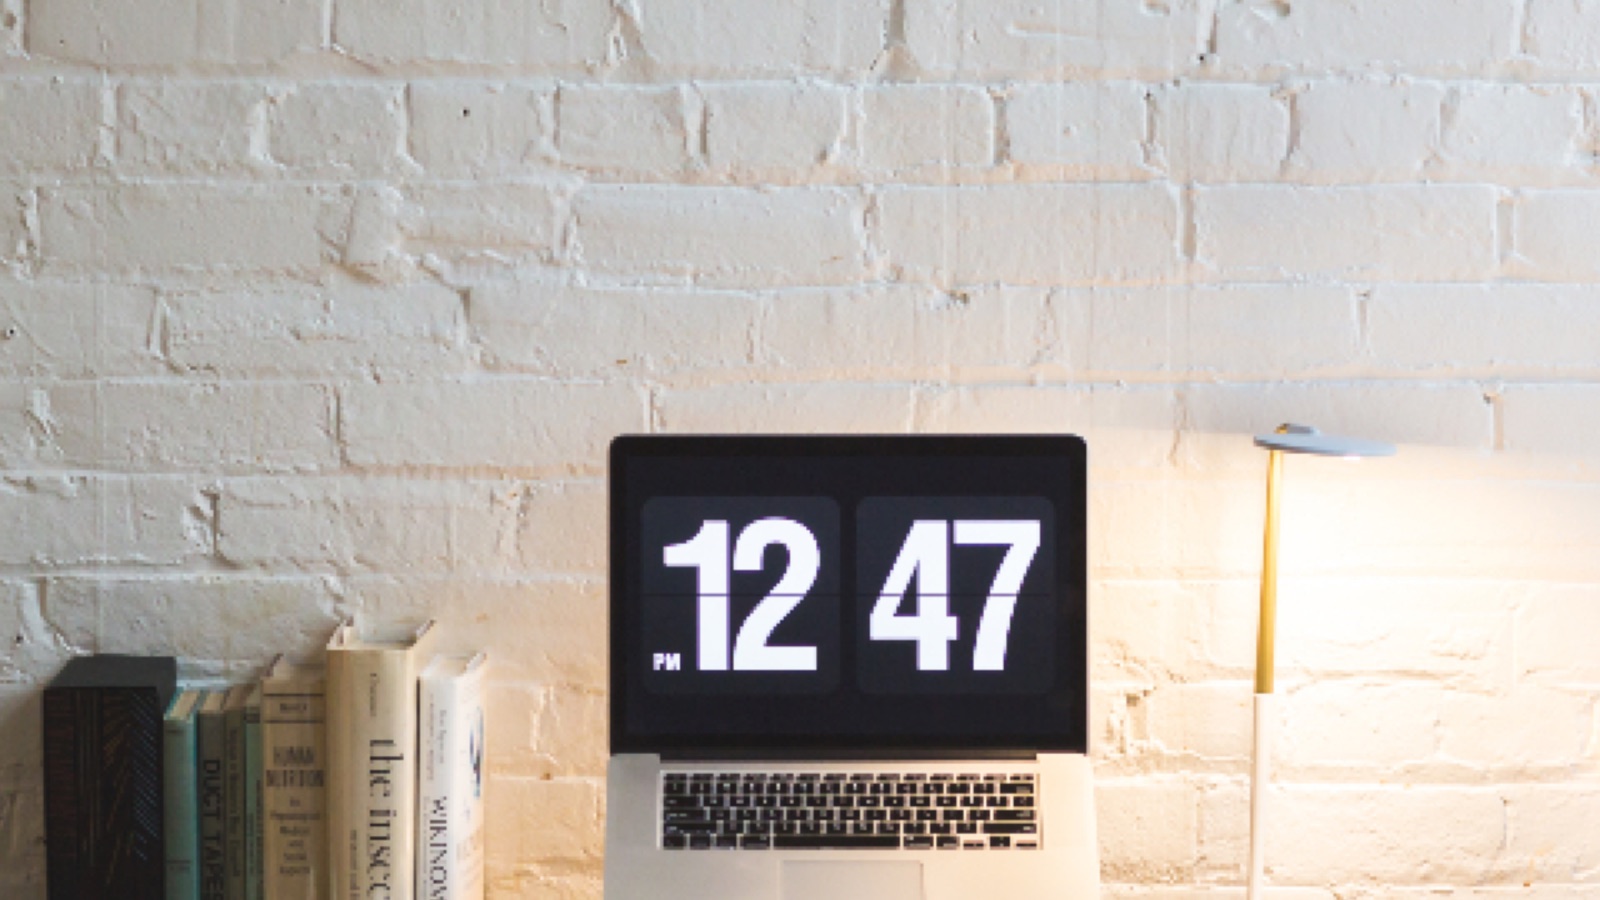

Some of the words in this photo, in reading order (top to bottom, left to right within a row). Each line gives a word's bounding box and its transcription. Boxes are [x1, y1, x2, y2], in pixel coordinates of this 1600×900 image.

[663, 516, 821, 670] 12
[869, 519, 1041, 670] 47
[653, 653, 680, 670] PM
[203, 759, 221, 821] DUCT
[369, 738, 404, 797] the
